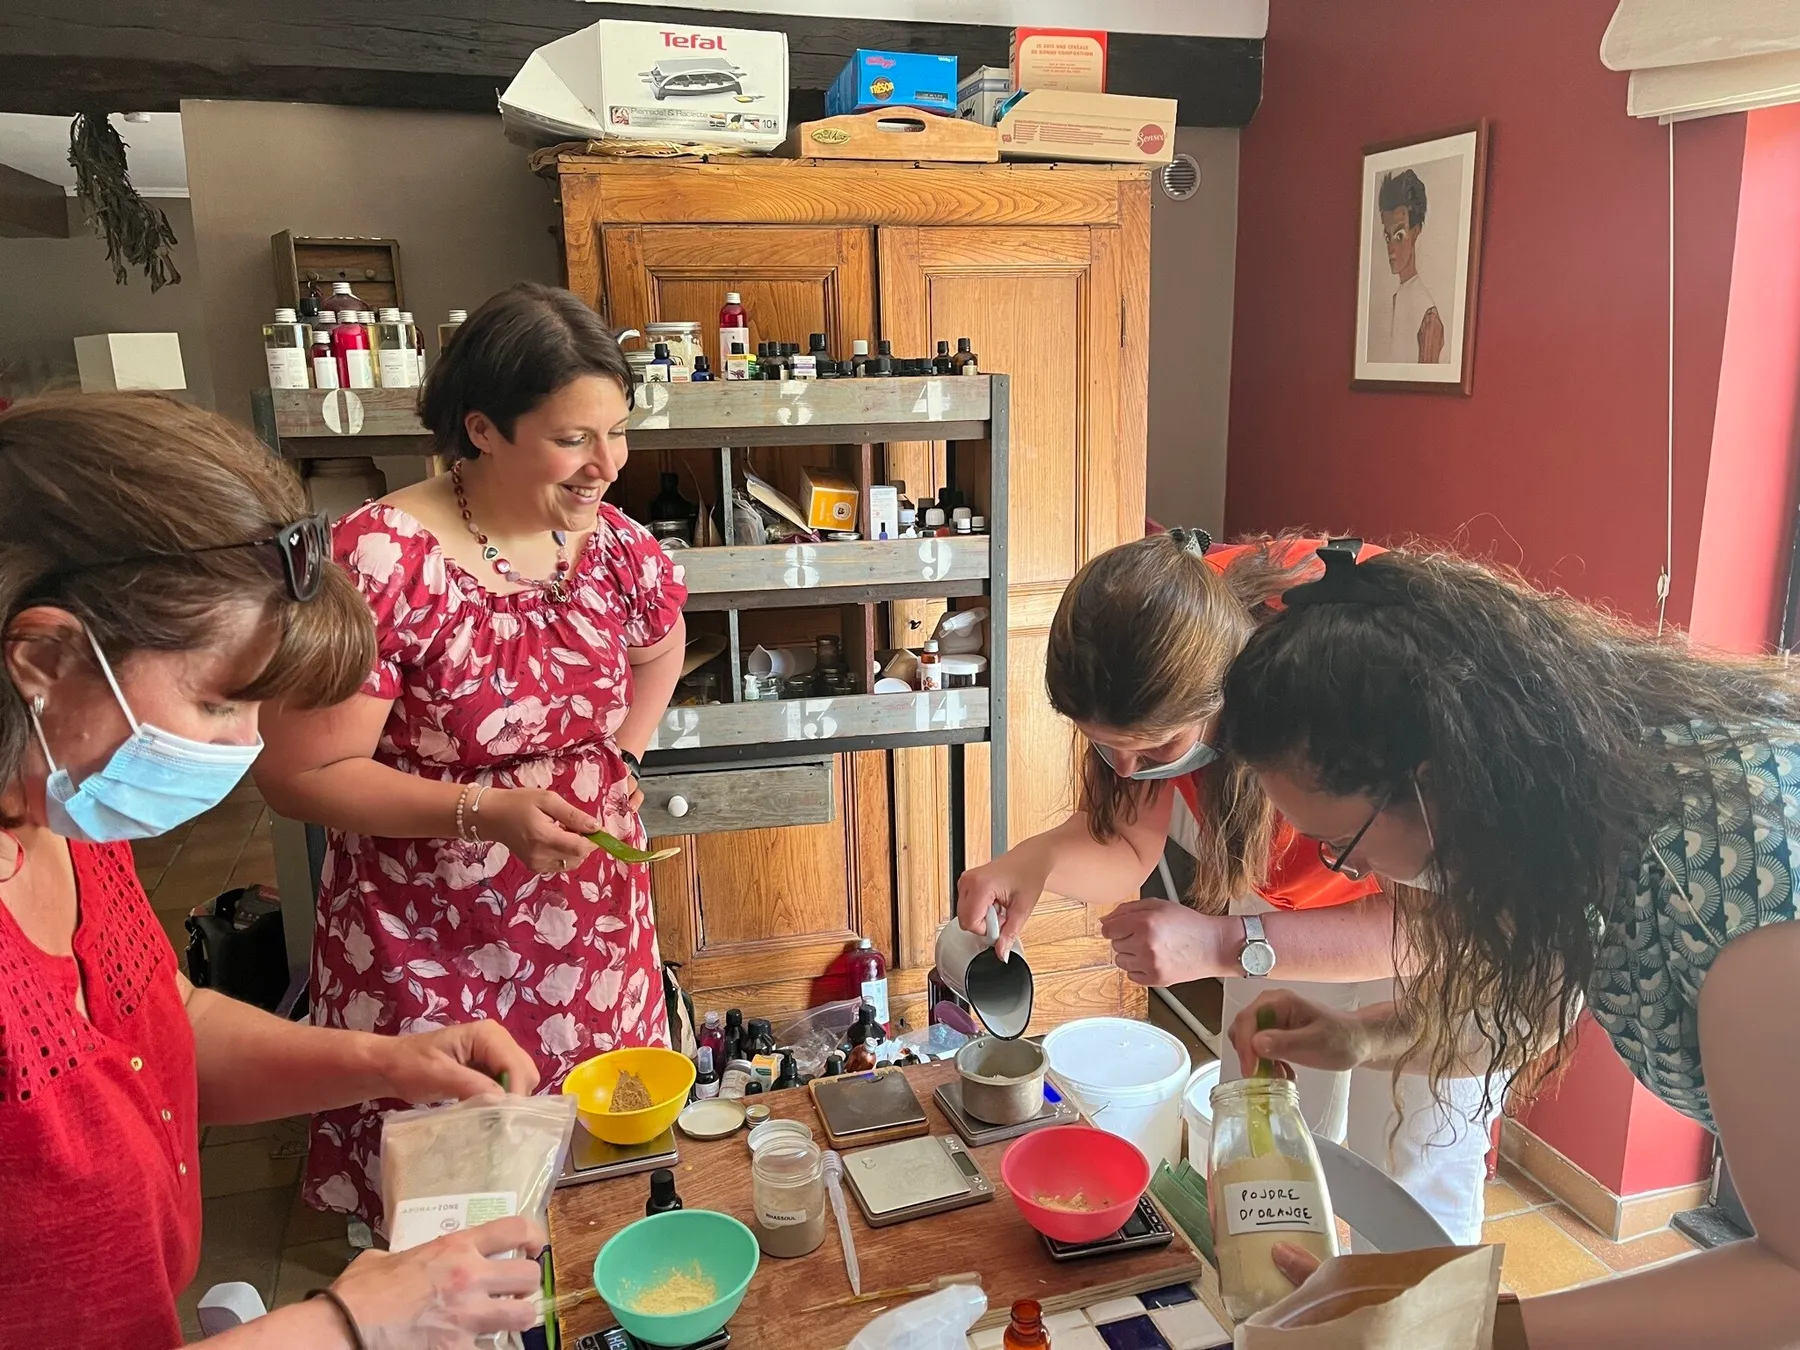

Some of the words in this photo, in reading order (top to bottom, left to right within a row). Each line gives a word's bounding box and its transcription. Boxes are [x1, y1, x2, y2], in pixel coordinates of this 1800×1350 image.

[659, 31, 727, 51] Tefal
[762, 119, 773, 129] 10
[634, 382, 670, 429] 2
[777, 379, 813, 425] 3
[912, 380, 950, 420] 4
[784, 545, 820, 588] 8
[918, 539, 952, 581] 9
[645, 708, 700, 750] 2
[781, 699, 837, 741] 13
[911, 690, 967, 731] 14
[1241, 1188, 1300, 1201] POUDRE
